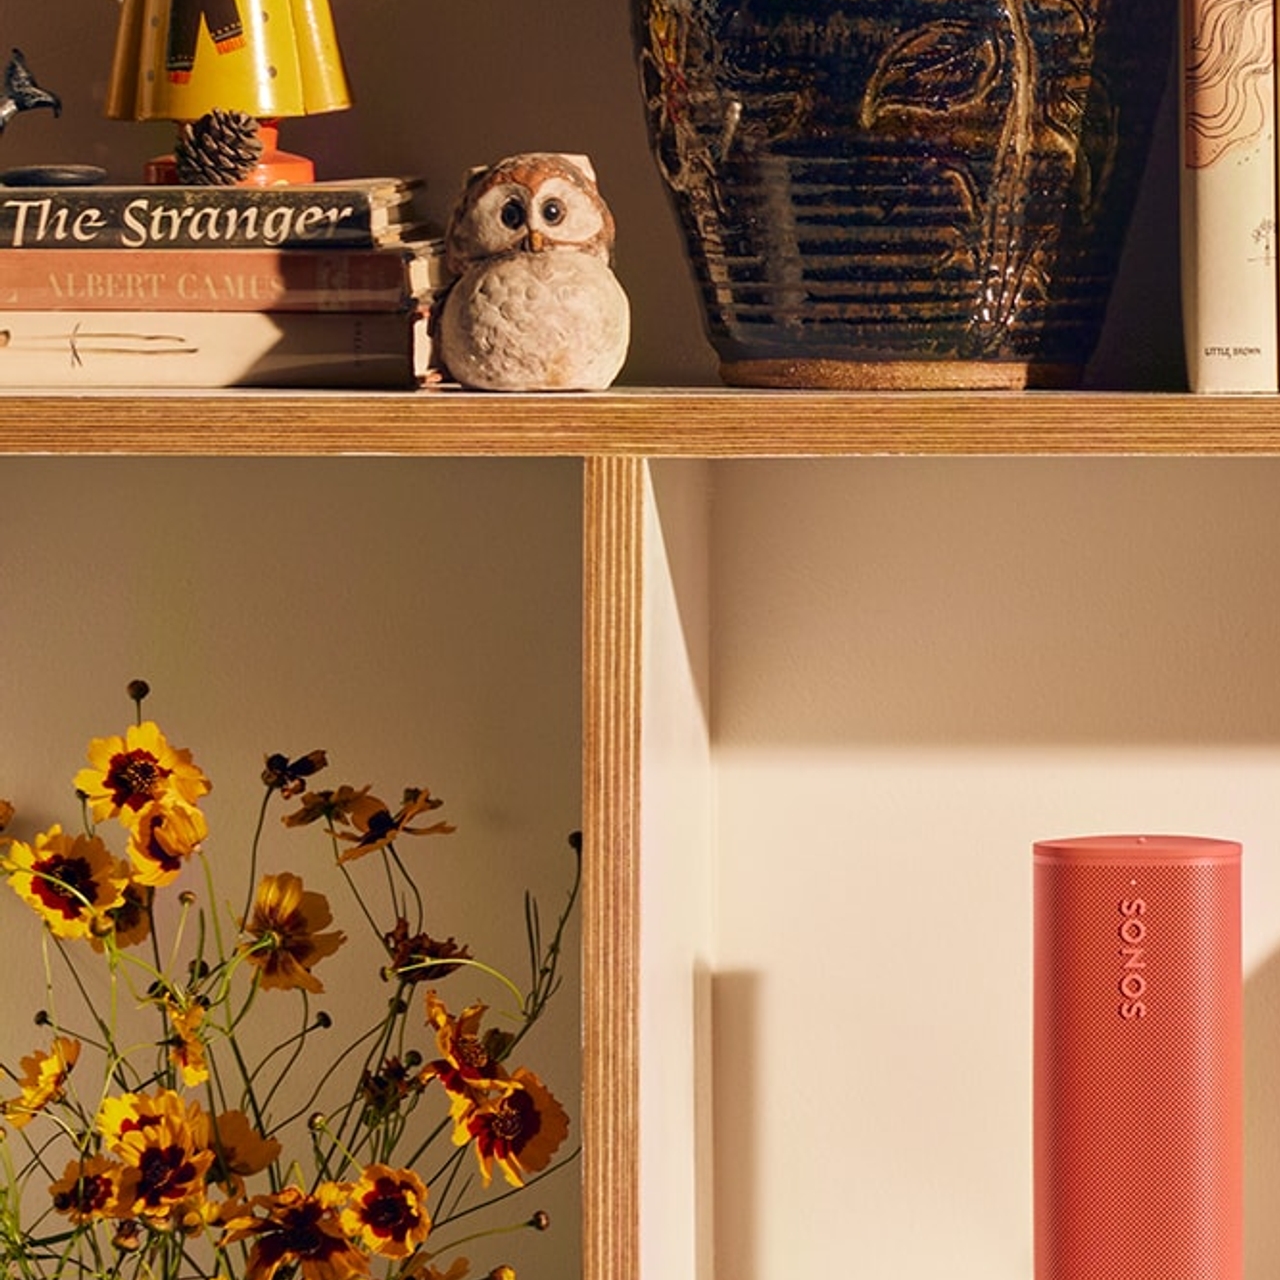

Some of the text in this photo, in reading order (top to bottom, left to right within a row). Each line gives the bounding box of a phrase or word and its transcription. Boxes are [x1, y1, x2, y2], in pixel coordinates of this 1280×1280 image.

[3, 197, 354, 249] The Stranger
[46, 273, 166, 300] ALBERT
[177, 272, 285, 301] CAMUS
[1117, 898, 1147, 1020] SONOS
